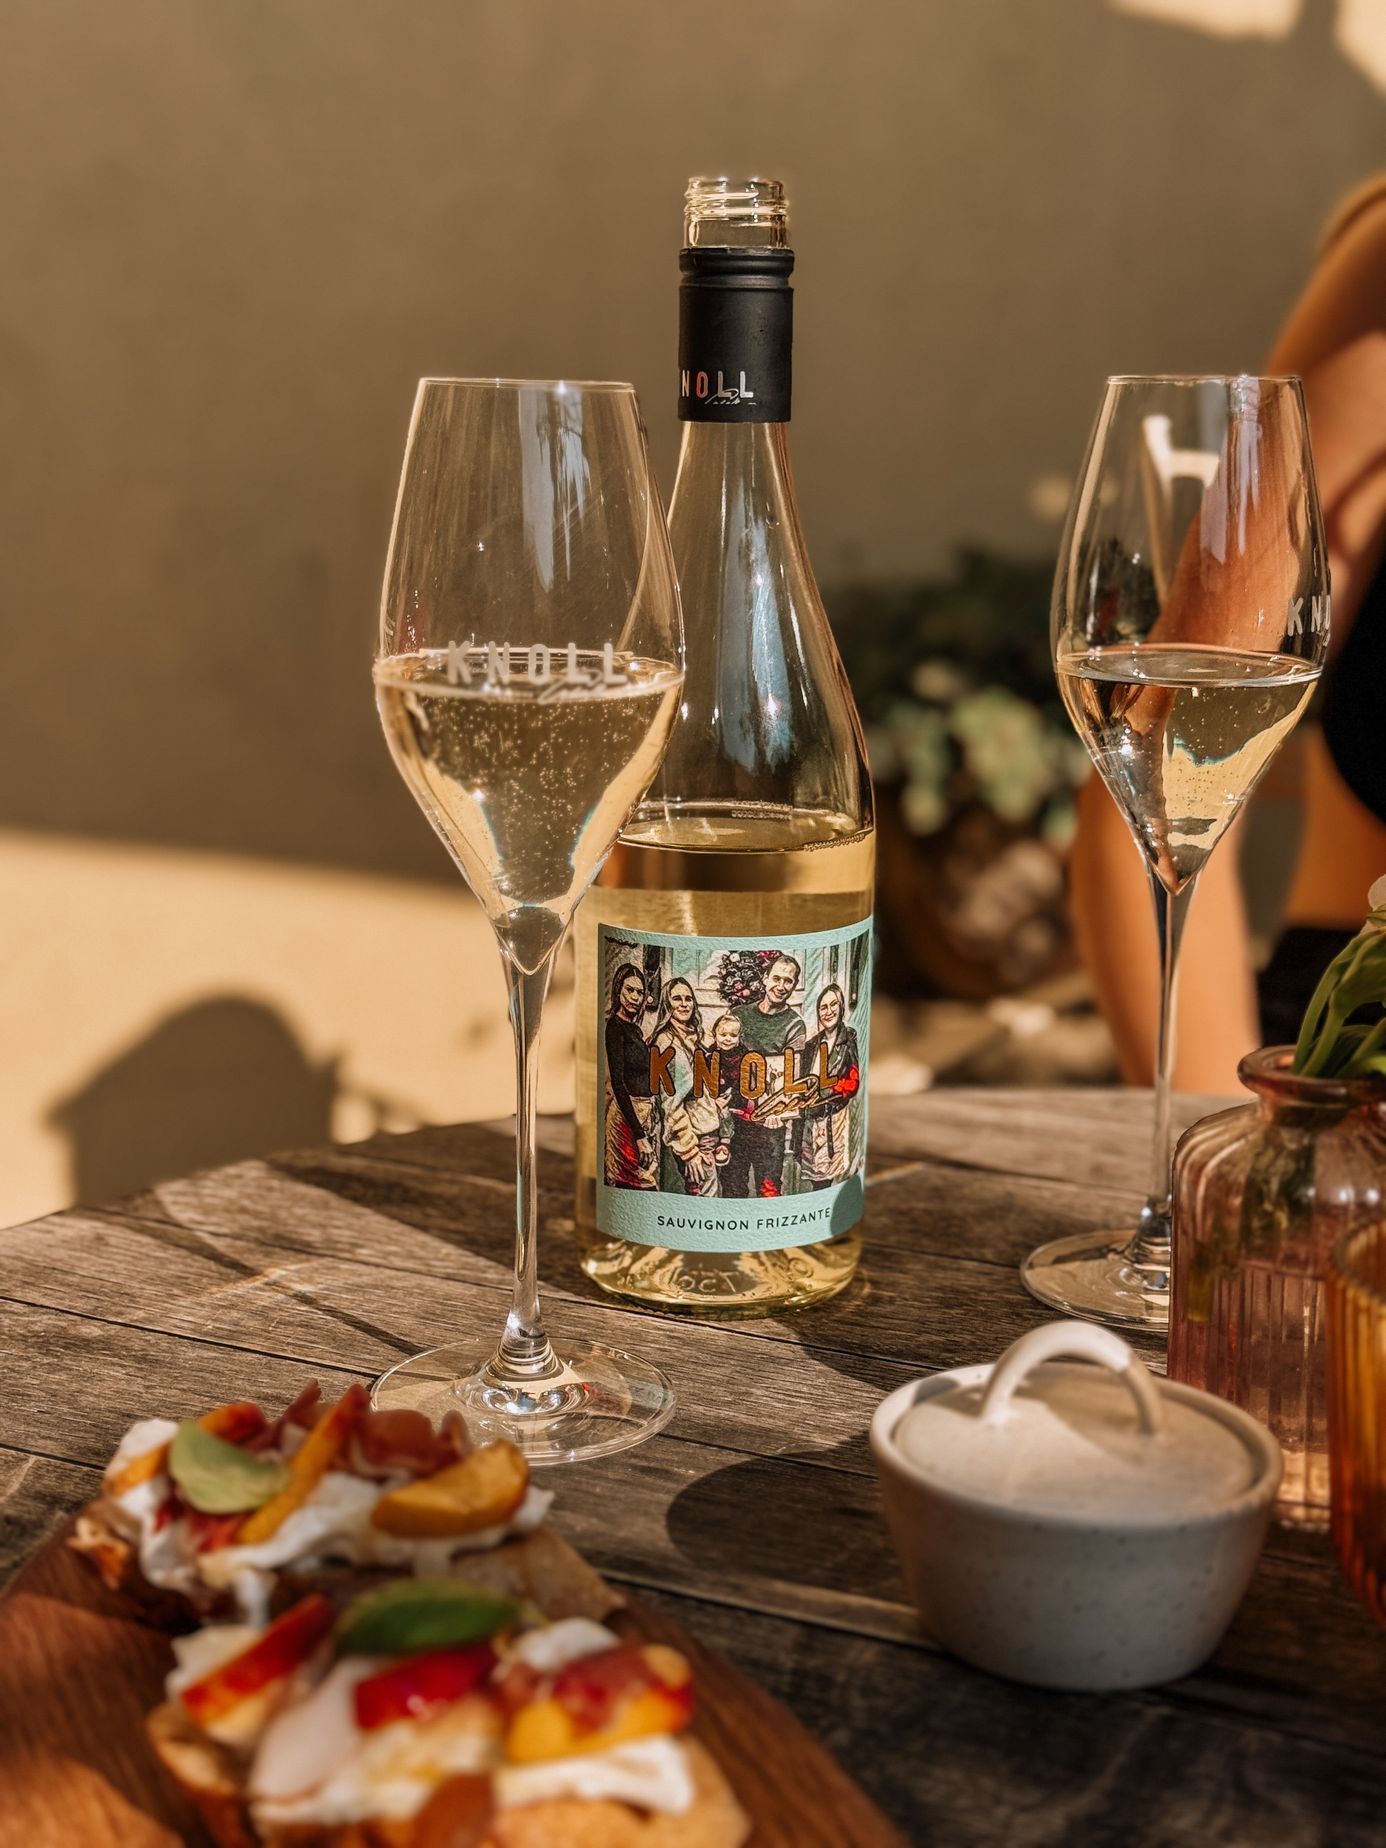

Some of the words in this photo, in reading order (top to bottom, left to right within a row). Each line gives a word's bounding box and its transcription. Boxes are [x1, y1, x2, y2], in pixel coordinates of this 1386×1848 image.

[447, 640, 628, 684] KNOLL
[649, 1042, 838, 1100] KNOLL
[657, 1215, 749, 1231] SAUVIGNON
[756, 1207, 831, 1229] FRIZZANTE
